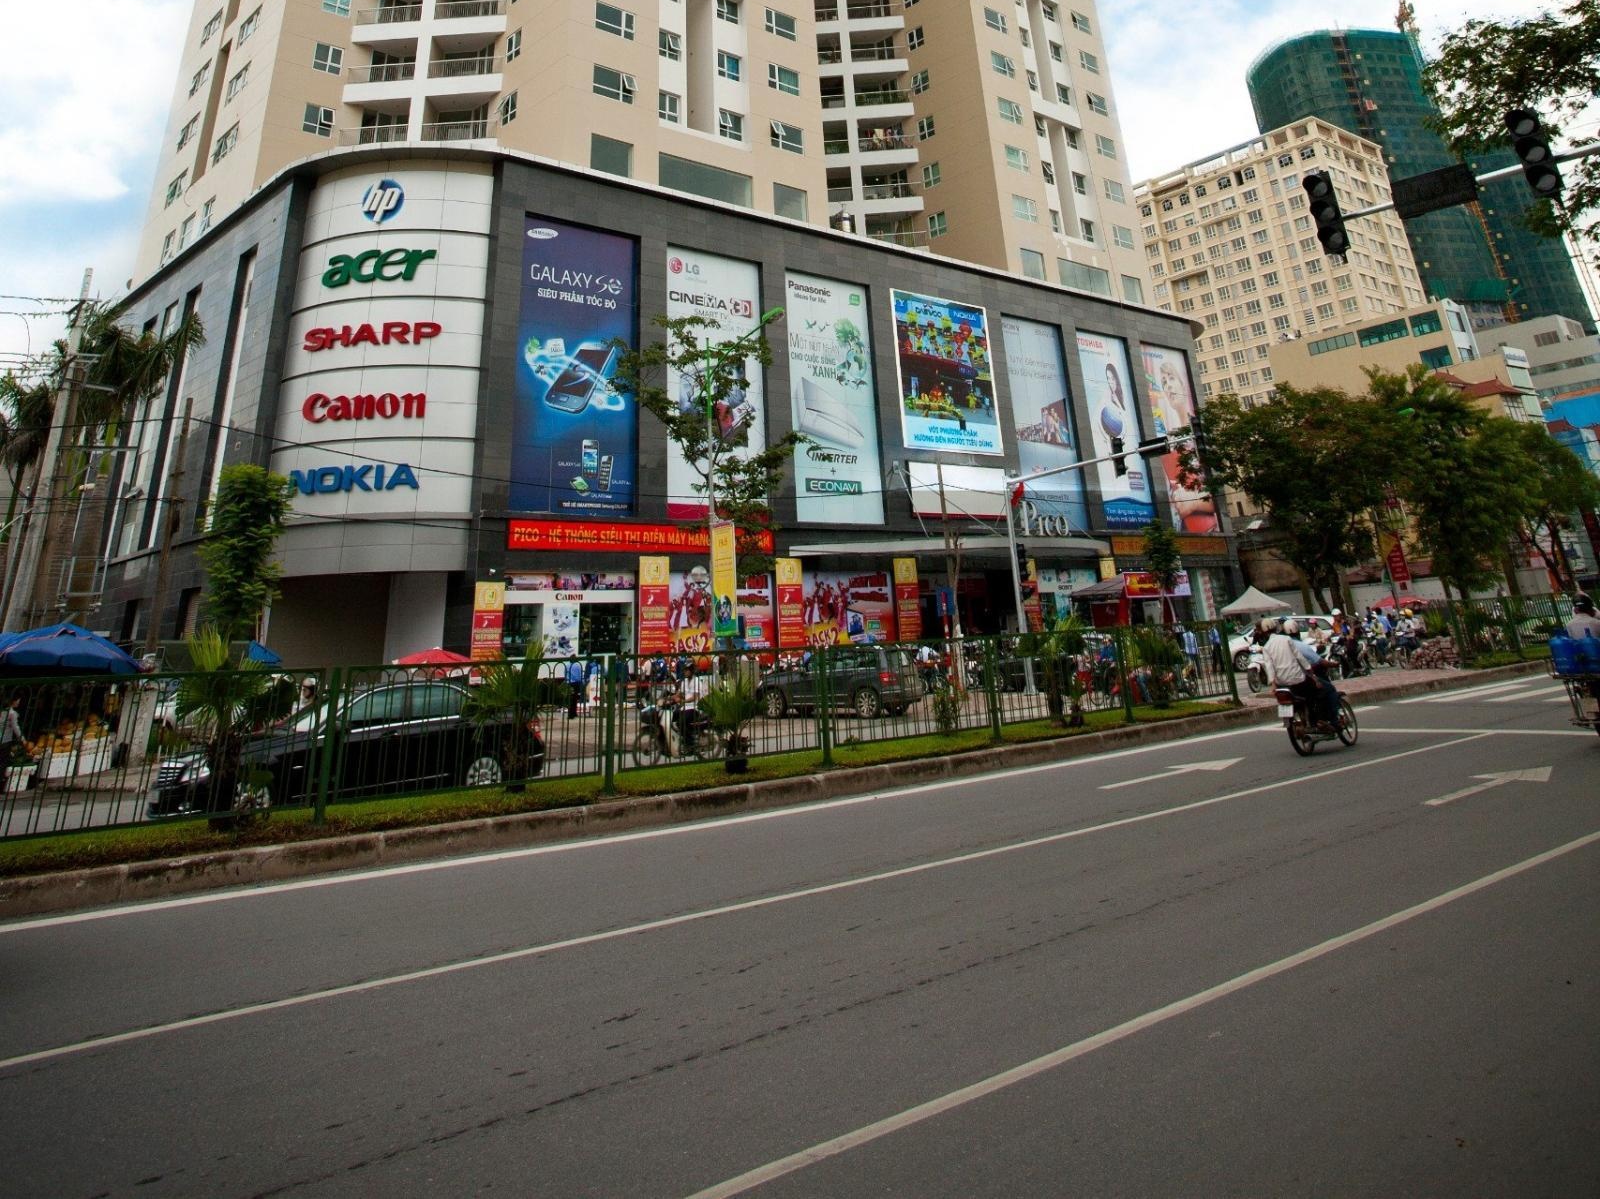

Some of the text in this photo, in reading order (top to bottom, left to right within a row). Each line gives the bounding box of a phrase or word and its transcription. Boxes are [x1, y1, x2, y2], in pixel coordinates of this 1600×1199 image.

[361, 180, 400, 224] hp
[322, 248, 437, 288] acer
[530, 263, 593, 289] GALAXY
[685, 262, 700, 275] LG
[788, 280, 832, 297] Panasonic
[669, 290, 752, 318] CINEMA 3D
[953, 311, 977, 322] NOKIA
[303, 321, 442, 351] SHARP
[1077, 336, 1104, 349] TOSHIBA
[302, 391, 426, 423] Canon
[290, 464, 420, 495] NOKIA
[810, 480, 859, 493] ECONAVI
[513, 528, 540, 542] PICO
[555, 592, 583, 601] Canon
[831, 627, 840, 644] 2
